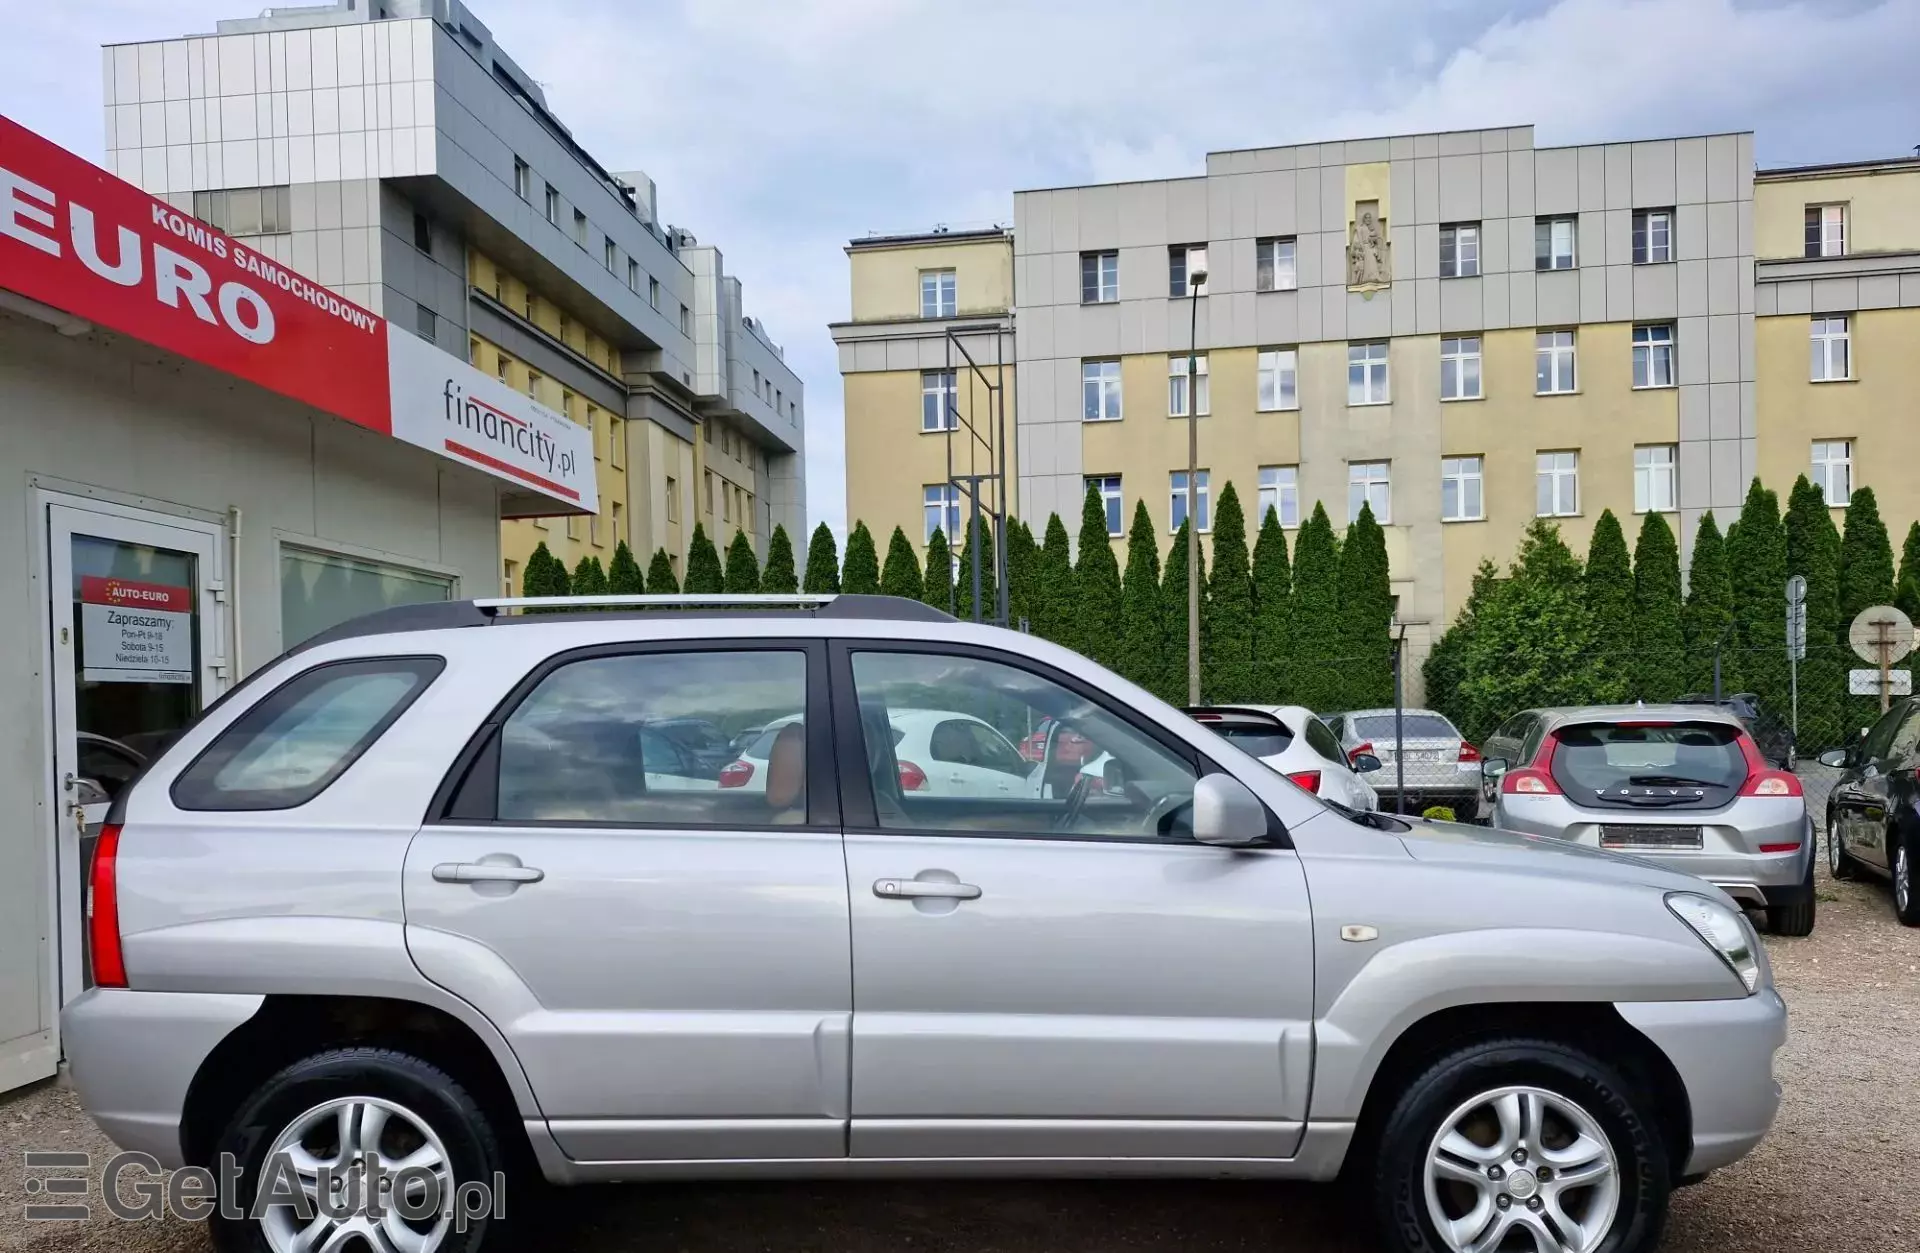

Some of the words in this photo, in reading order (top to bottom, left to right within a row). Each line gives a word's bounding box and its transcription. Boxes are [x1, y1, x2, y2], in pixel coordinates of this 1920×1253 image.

[152, 203, 227, 259] KOMIS
[233, 247, 377, 335] SAMOCHODOWY
[444, 378, 576, 478] financity.pl
[112, 587, 169, 602] AUTO-EURO
[121, 629, 146, 640] Pon-Pt
[121, 641, 146, 652] Sobota
[147, 642, 164, 653] 9-15
[115, 653, 148, 664] Niedziela
